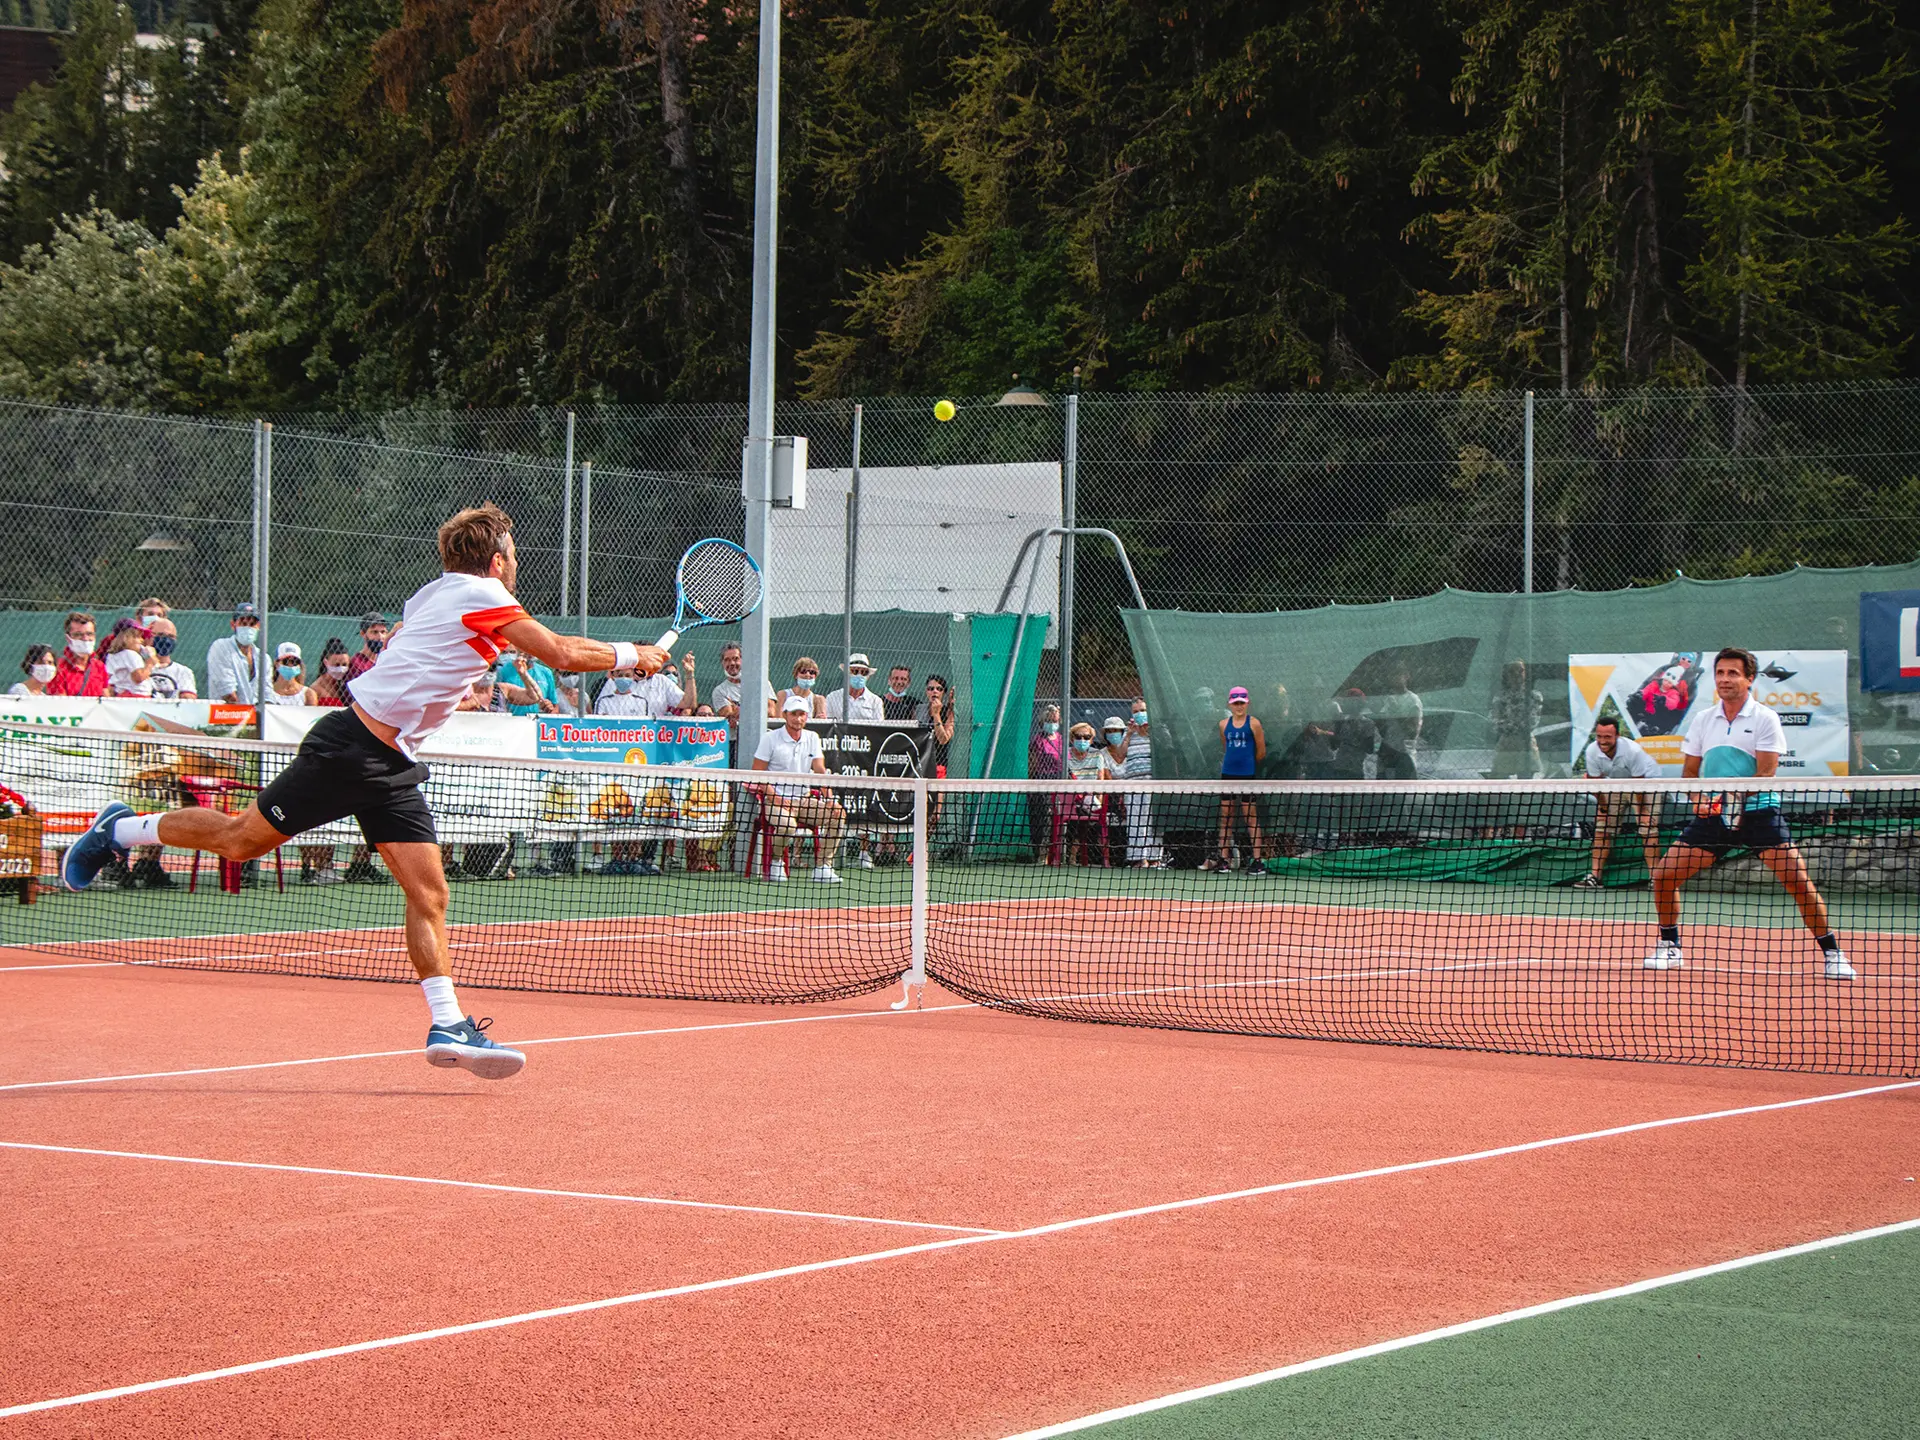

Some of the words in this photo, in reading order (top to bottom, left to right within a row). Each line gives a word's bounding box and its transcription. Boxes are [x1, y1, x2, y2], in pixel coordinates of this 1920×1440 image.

[540, 723, 557, 741] La
[561, 724, 655, 743] Tourtonnerie
[657, 725, 674, 743] de
